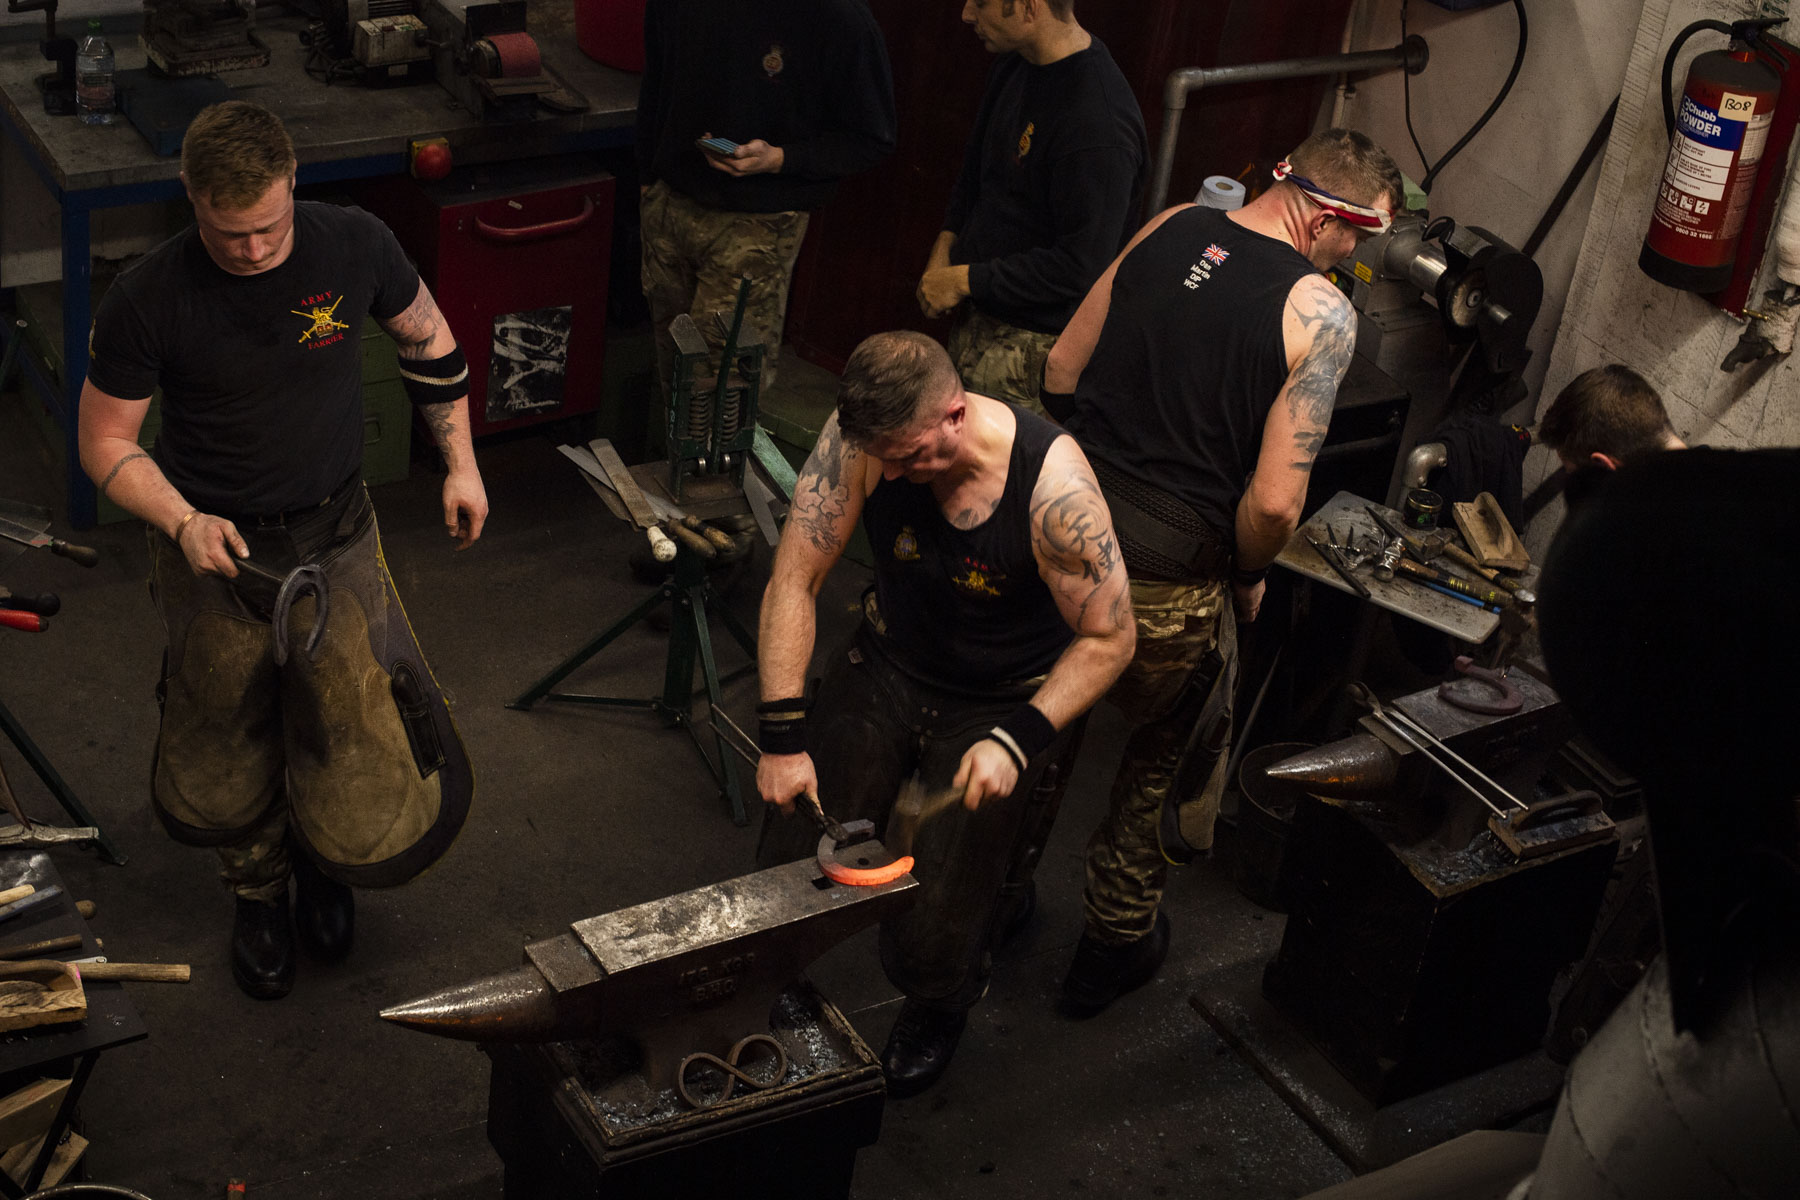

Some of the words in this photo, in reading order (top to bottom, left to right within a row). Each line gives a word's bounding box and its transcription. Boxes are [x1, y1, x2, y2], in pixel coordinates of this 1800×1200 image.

[1688, 103, 1717, 122] Chubb
[1679, 108, 1722, 137] POWDER
[1190, 264, 1211, 280] Martin
[300, 290, 333, 307] ARMY
[307, 333, 344, 351] FARRIER
